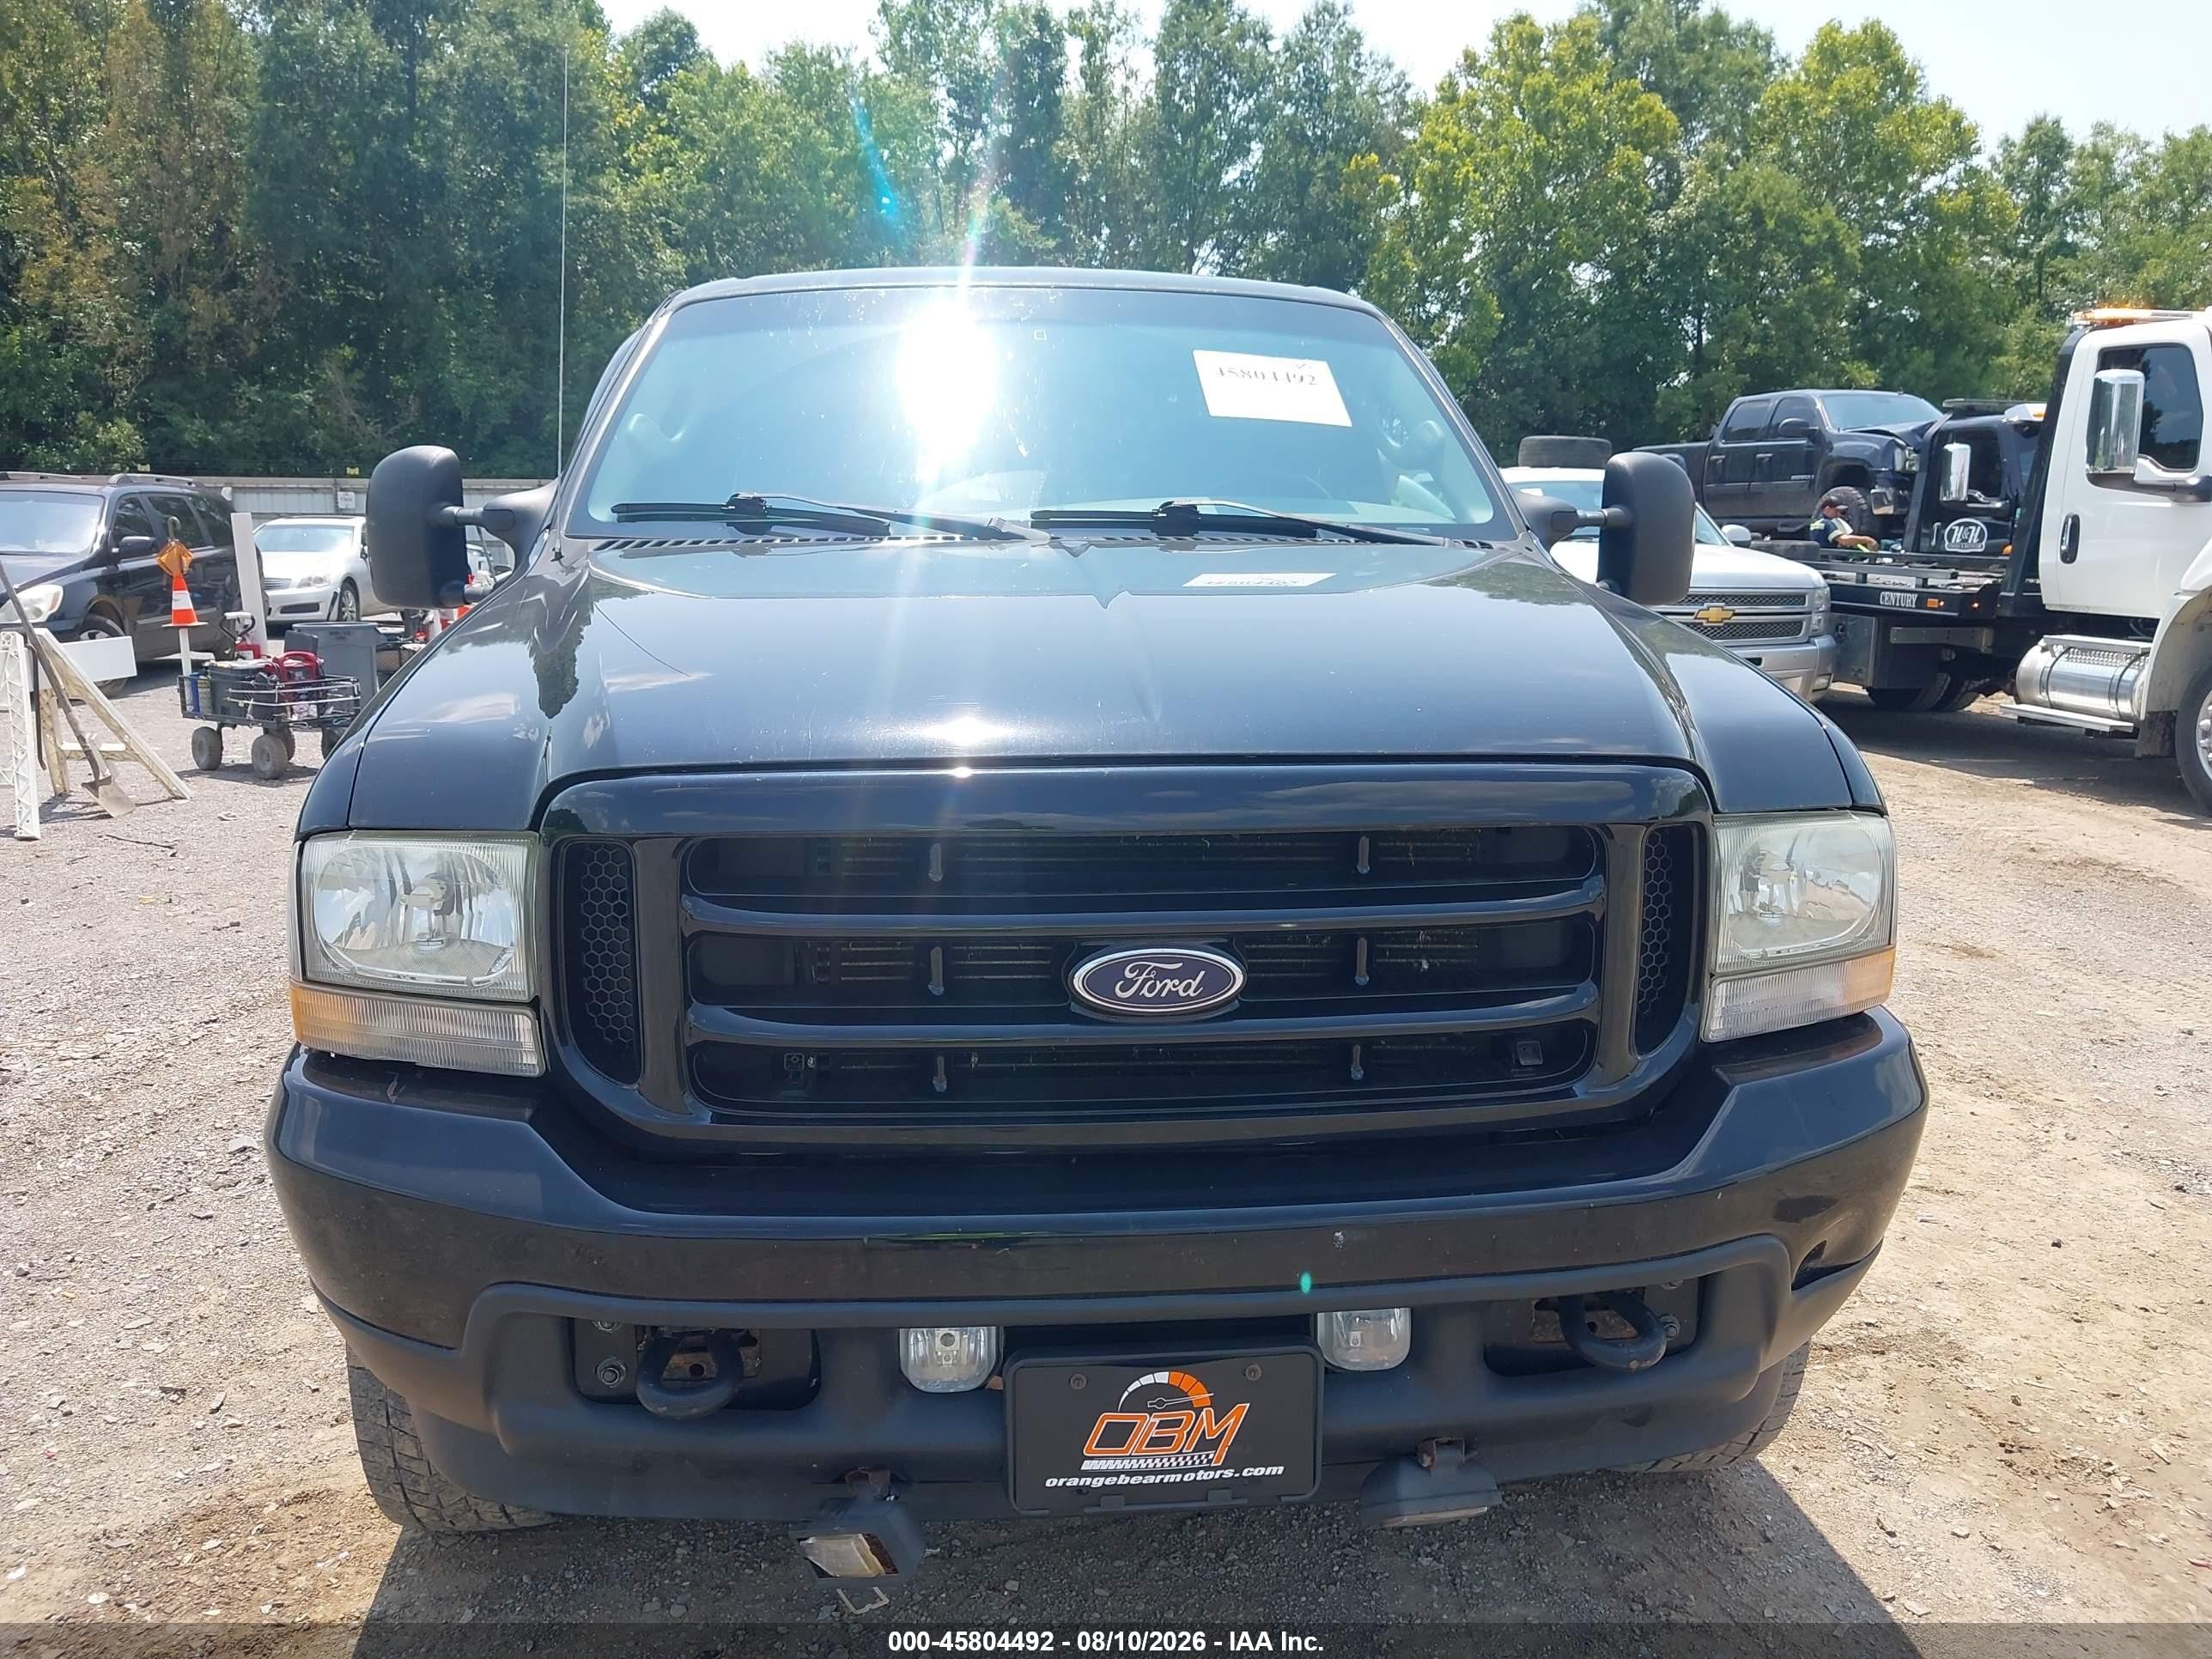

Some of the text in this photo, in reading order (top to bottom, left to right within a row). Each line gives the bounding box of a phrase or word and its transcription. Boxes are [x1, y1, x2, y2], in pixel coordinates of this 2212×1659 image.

[1879, 591, 1918, 608] CENTURY
[1115, 961, 1206, 999] Ford
[1083, 1403, 1250, 1467] OBM
[1044, 1465, 1285, 1488] orangebearmotors.com
